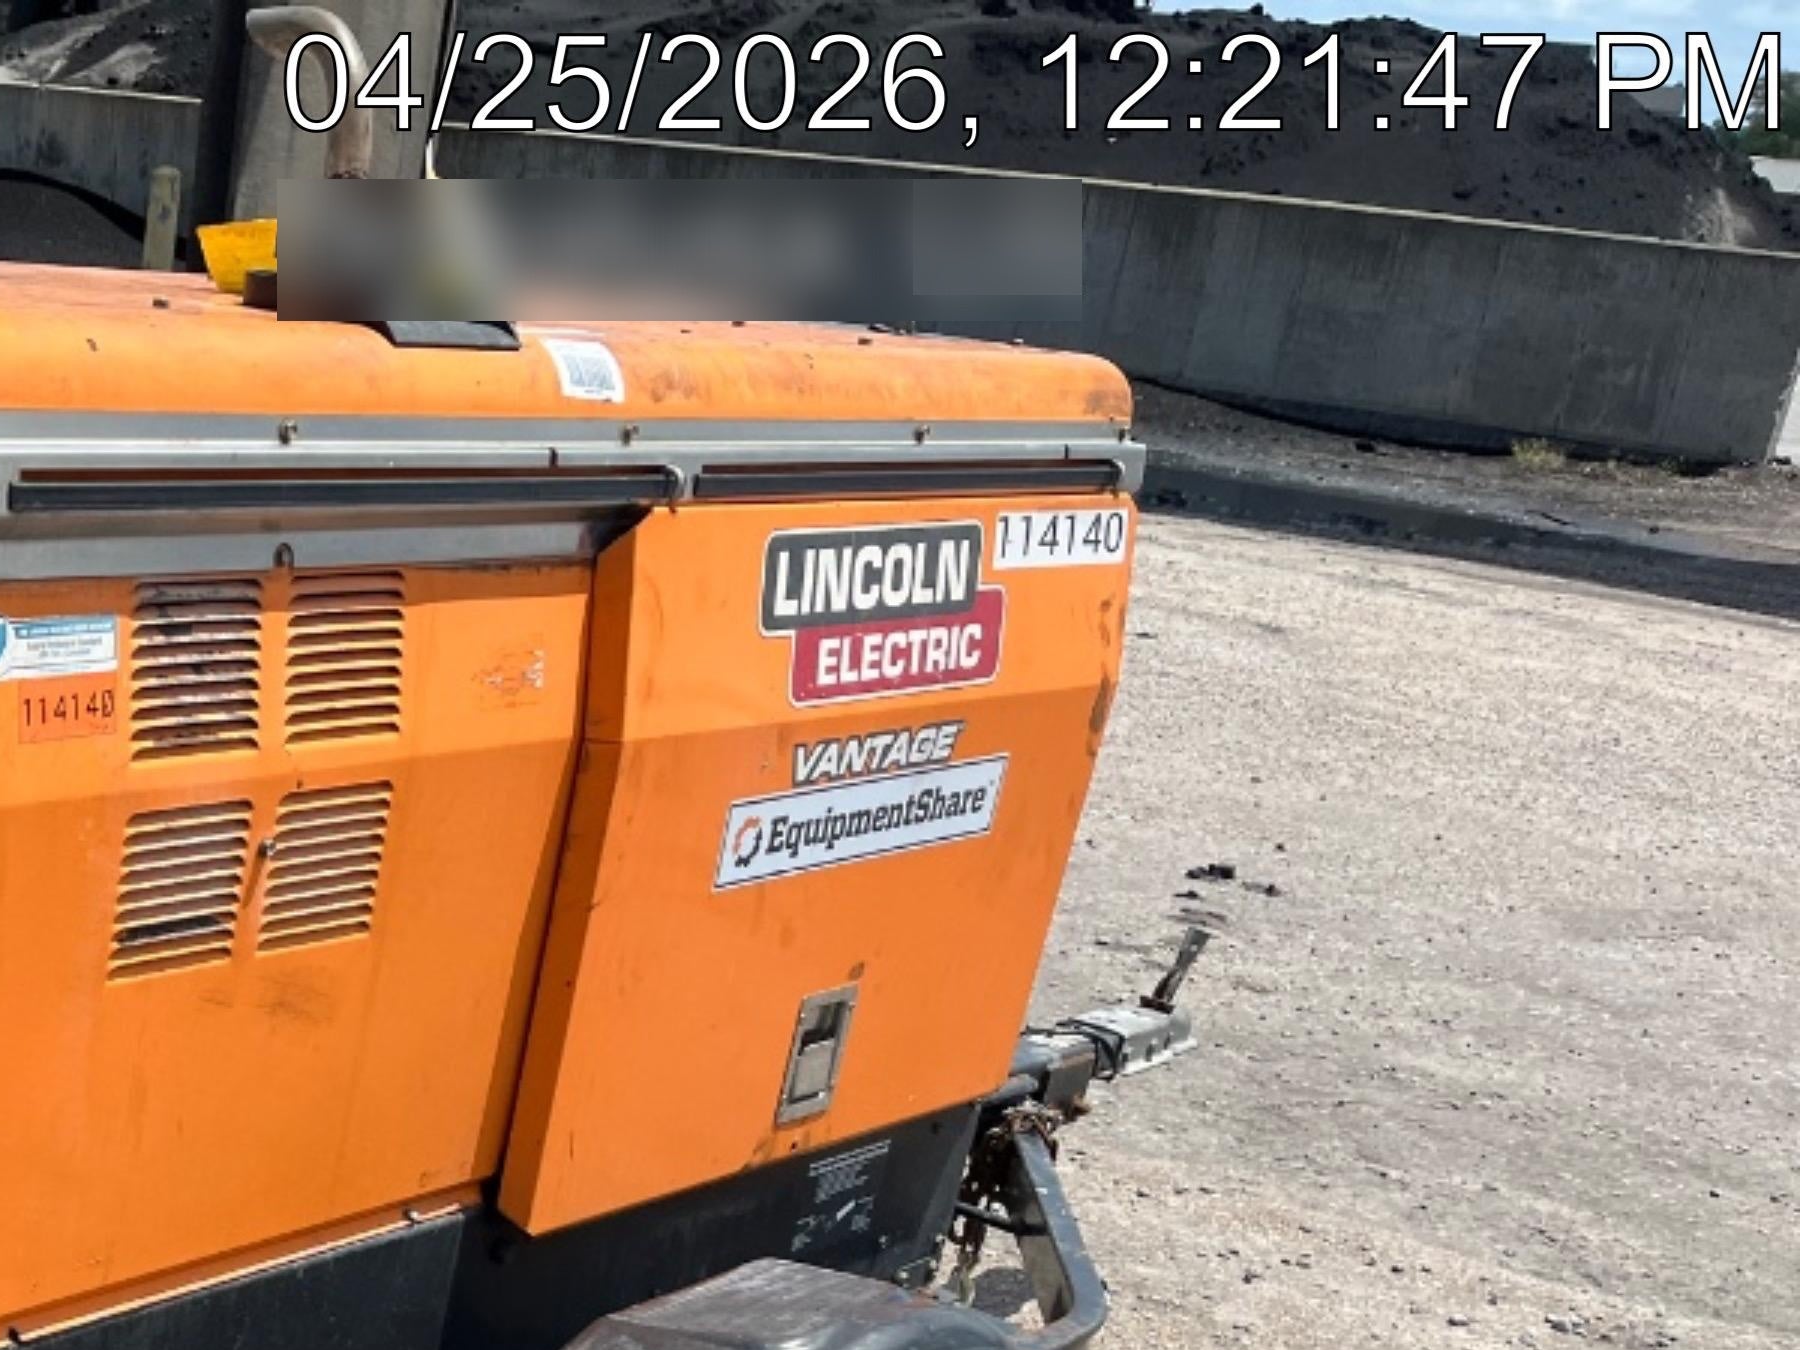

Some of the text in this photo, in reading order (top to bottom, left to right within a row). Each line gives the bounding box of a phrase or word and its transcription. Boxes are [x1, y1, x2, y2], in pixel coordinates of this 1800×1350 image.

[998, 512, 1124, 558] 114140
[773, 540, 970, 617] LINCOLN
[816, 623, 983, 686] ELECTRIC
[23, 689, 114, 727] 114140
[794, 721, 960, 783] VANTAGE
[765, 785, 988, 858] EquipmentShare
